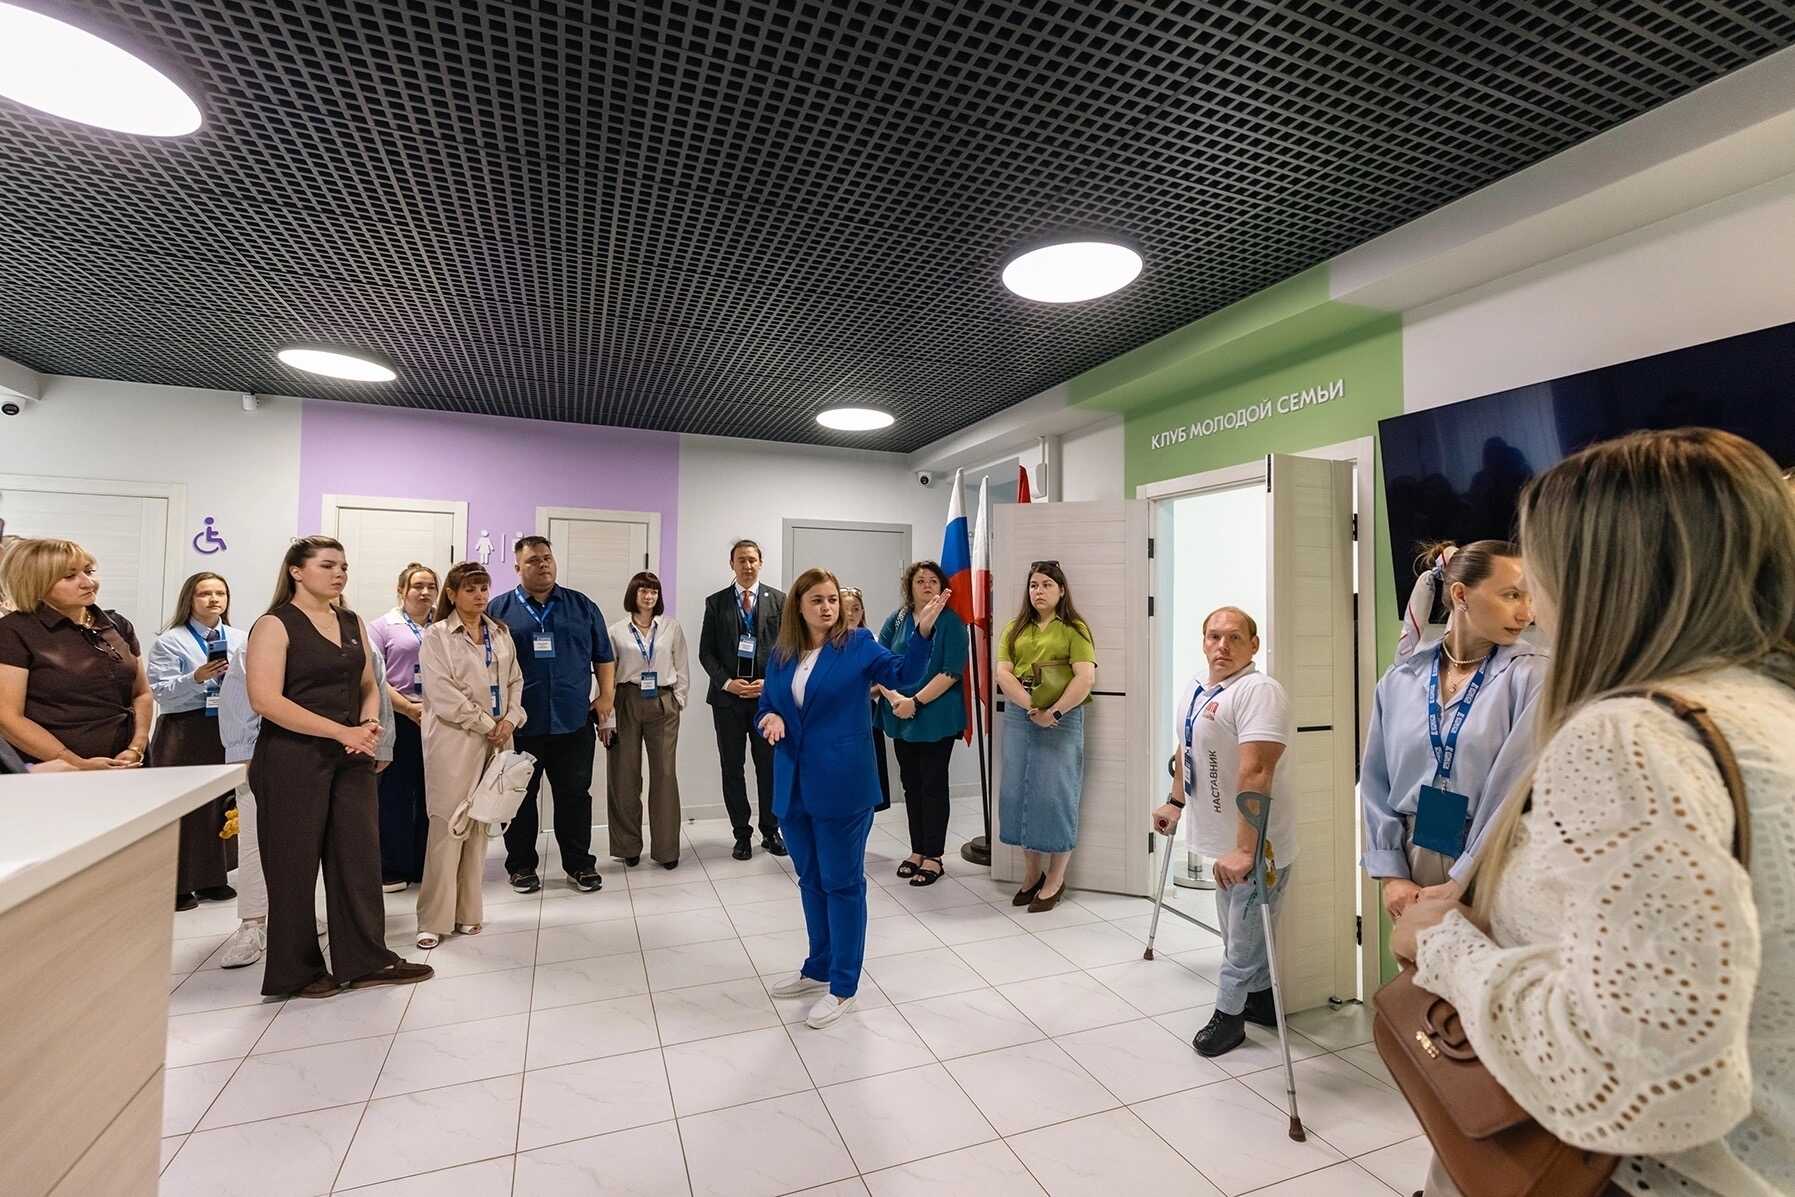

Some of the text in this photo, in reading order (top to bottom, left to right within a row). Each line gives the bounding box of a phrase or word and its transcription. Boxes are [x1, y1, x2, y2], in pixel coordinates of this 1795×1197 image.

[1151, 379, 1344, 449] КЛУБ МОЛОДОЙ СЕМЬИ
[1207, 750, 1222, 814] НАСТАВНИК
